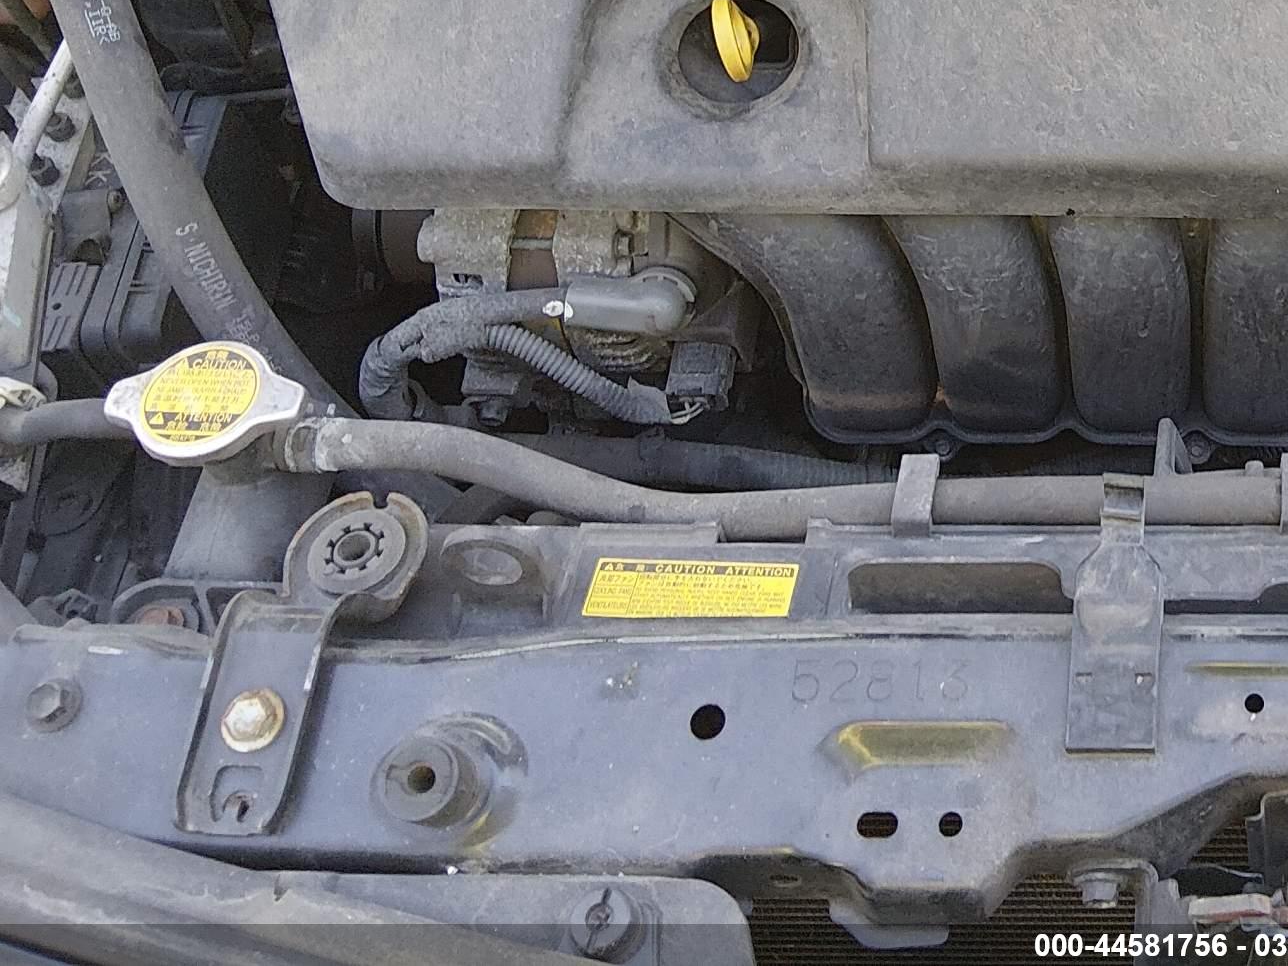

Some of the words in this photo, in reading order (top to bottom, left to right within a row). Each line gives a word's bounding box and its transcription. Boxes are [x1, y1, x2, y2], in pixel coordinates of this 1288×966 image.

[192, 359, 247, 370] CAUTION
[175, 412, 232, 424] ATTENTION
[655, 564, 716, 575] CAUTION
[725, 566, 791, 577] ATTENTION
